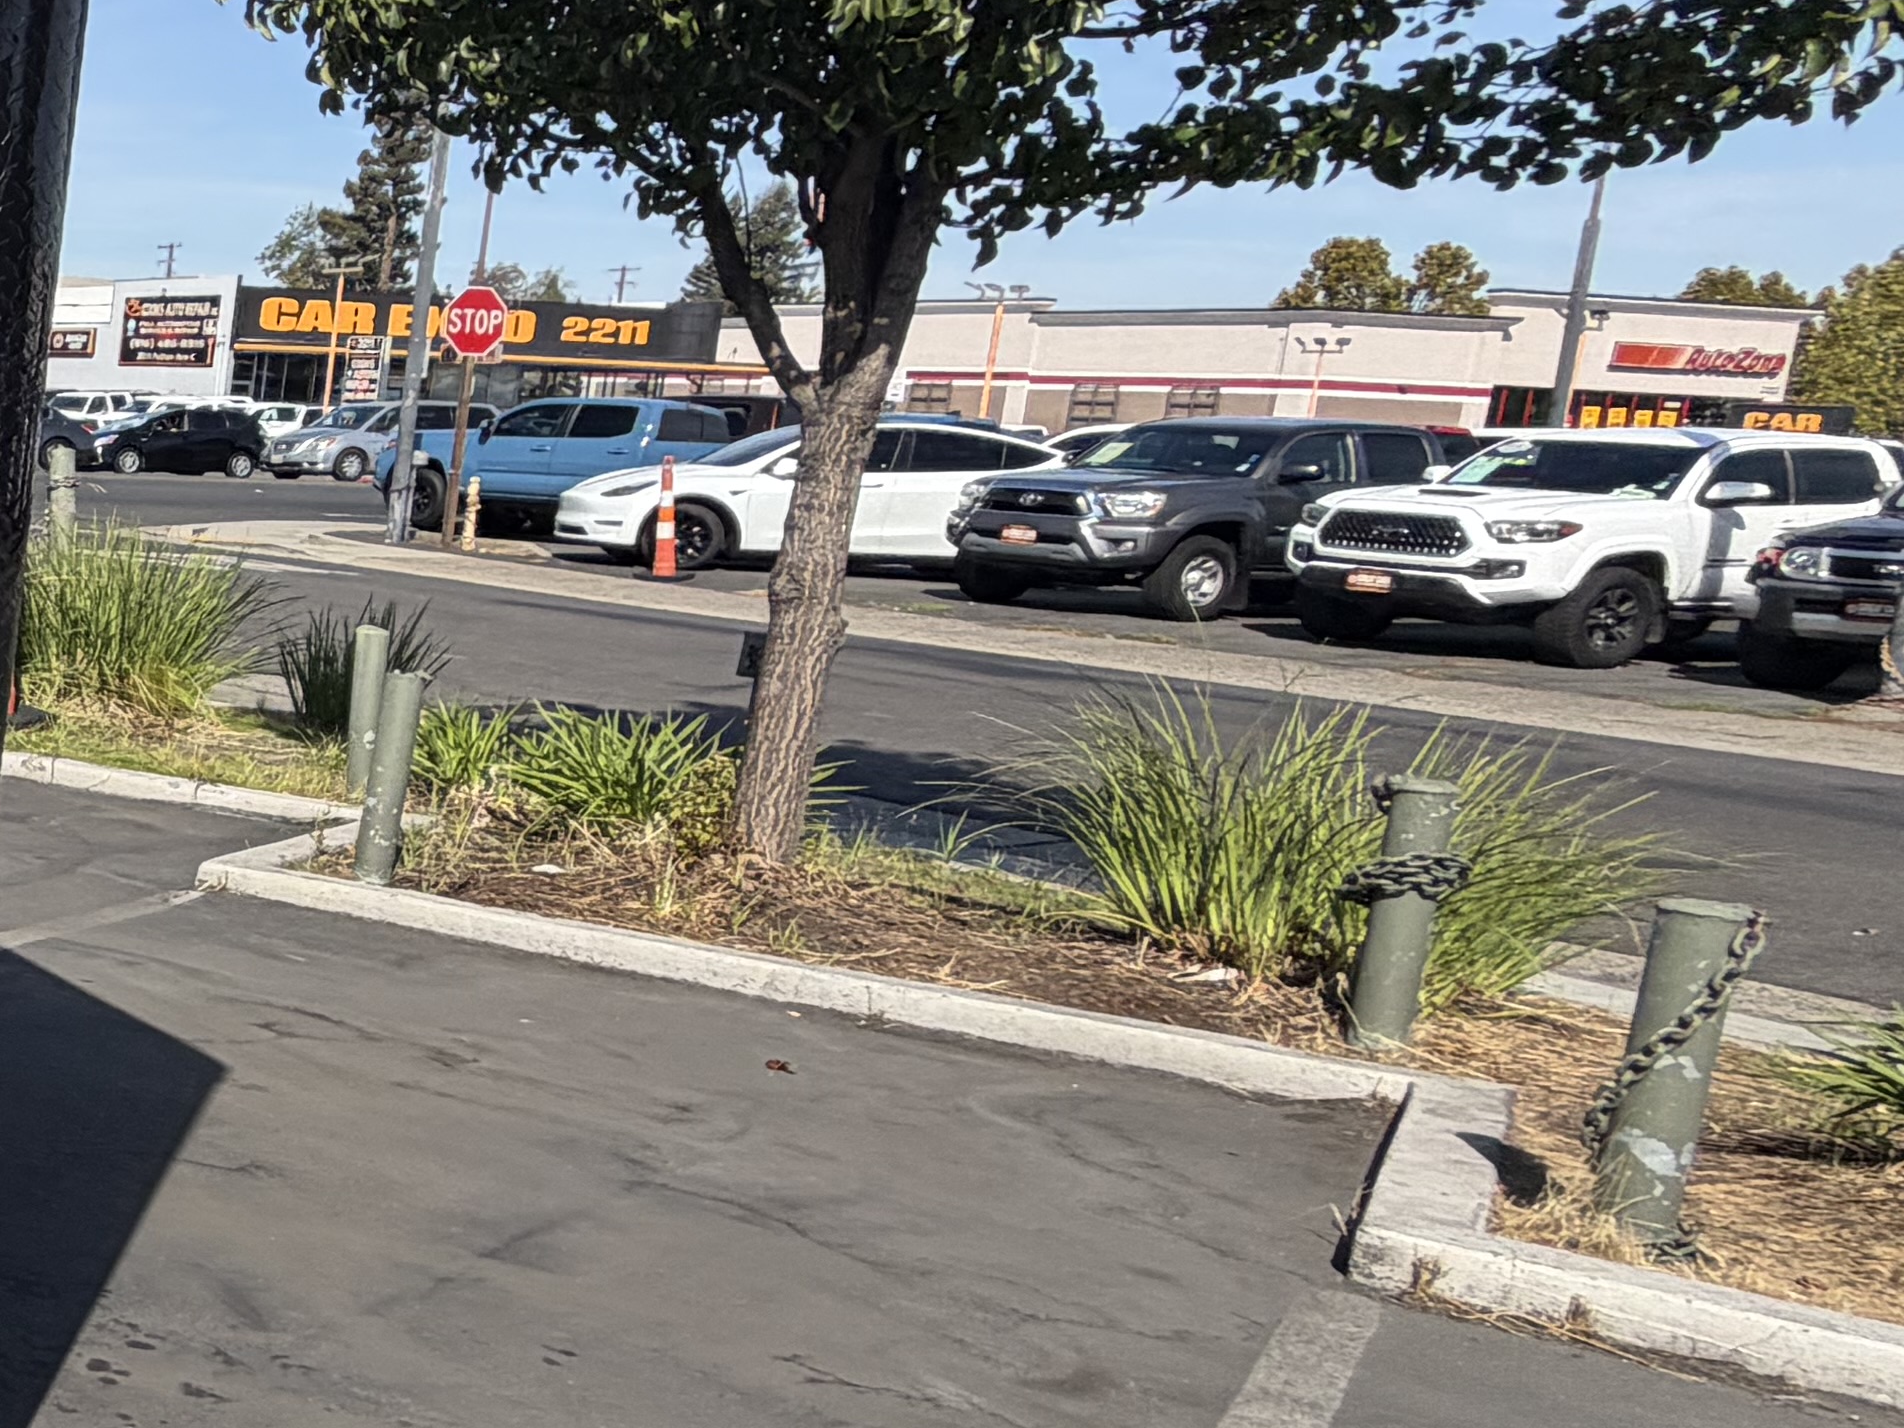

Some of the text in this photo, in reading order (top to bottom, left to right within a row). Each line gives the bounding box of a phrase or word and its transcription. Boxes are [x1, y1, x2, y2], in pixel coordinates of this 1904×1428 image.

[259, 297, 376, 335] CAR
[560, 316, 651, 346] 2211
[448, 308, 502, 335] STOP
[1685, 347, 1787, 373] AutoZone
[1743, 411, 1823, 433] CAR
